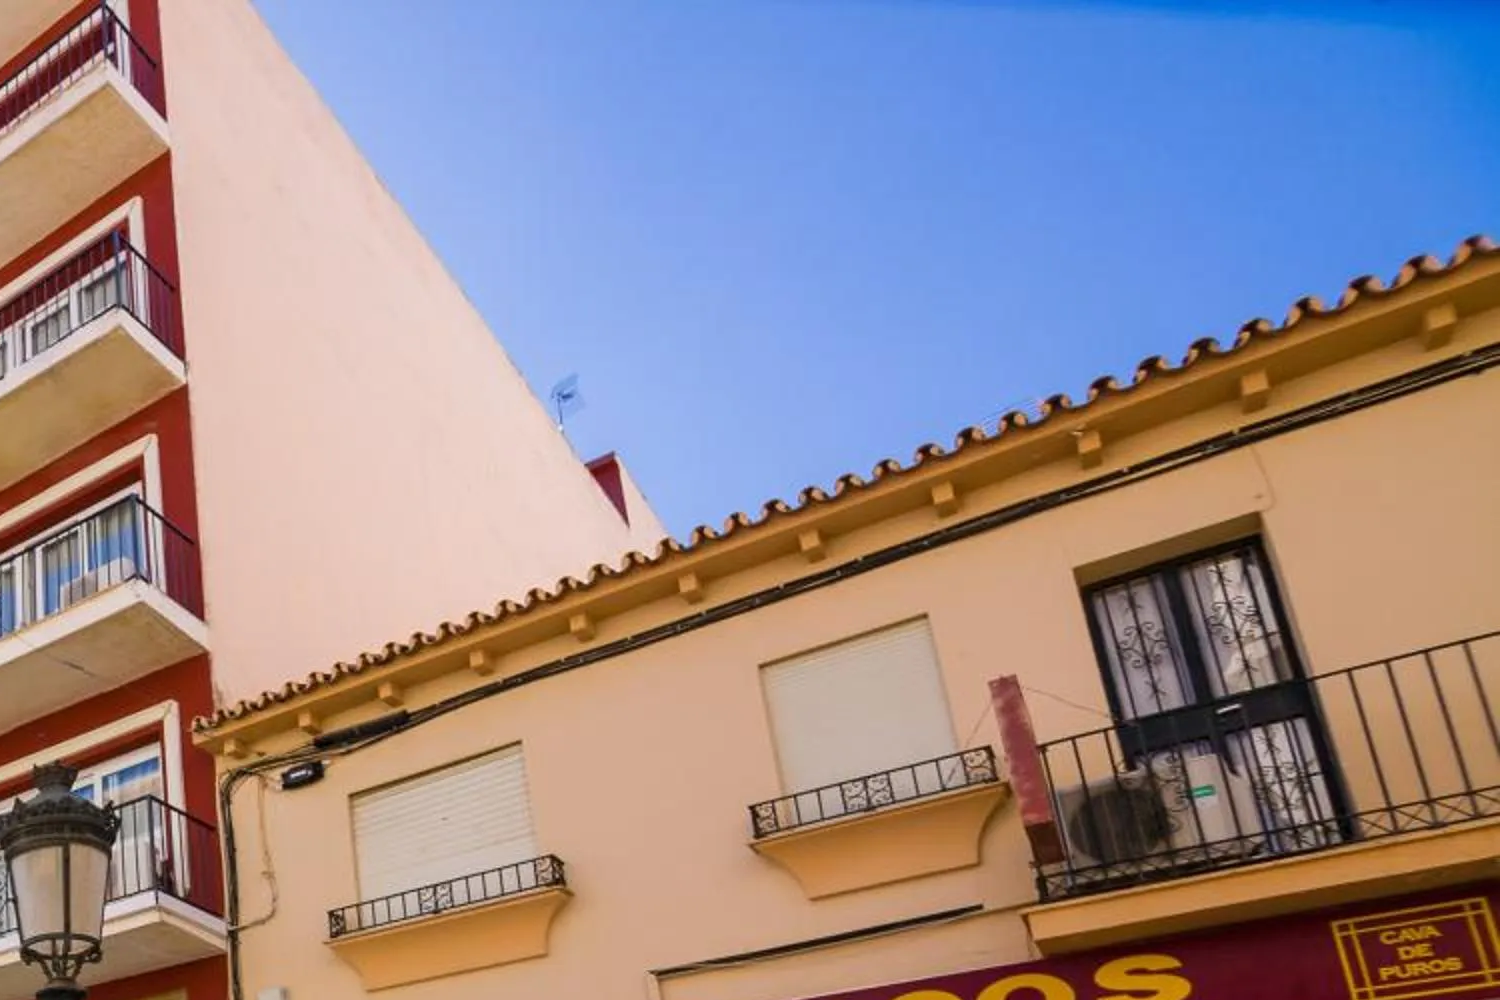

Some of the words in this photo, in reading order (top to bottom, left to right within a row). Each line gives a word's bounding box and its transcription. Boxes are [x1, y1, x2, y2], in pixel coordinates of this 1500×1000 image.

[1379, 925, 1443, 945] CAVA
[1397, 943, 1434, 961] DE
[1379, 956, 1463, 981] PUROS
